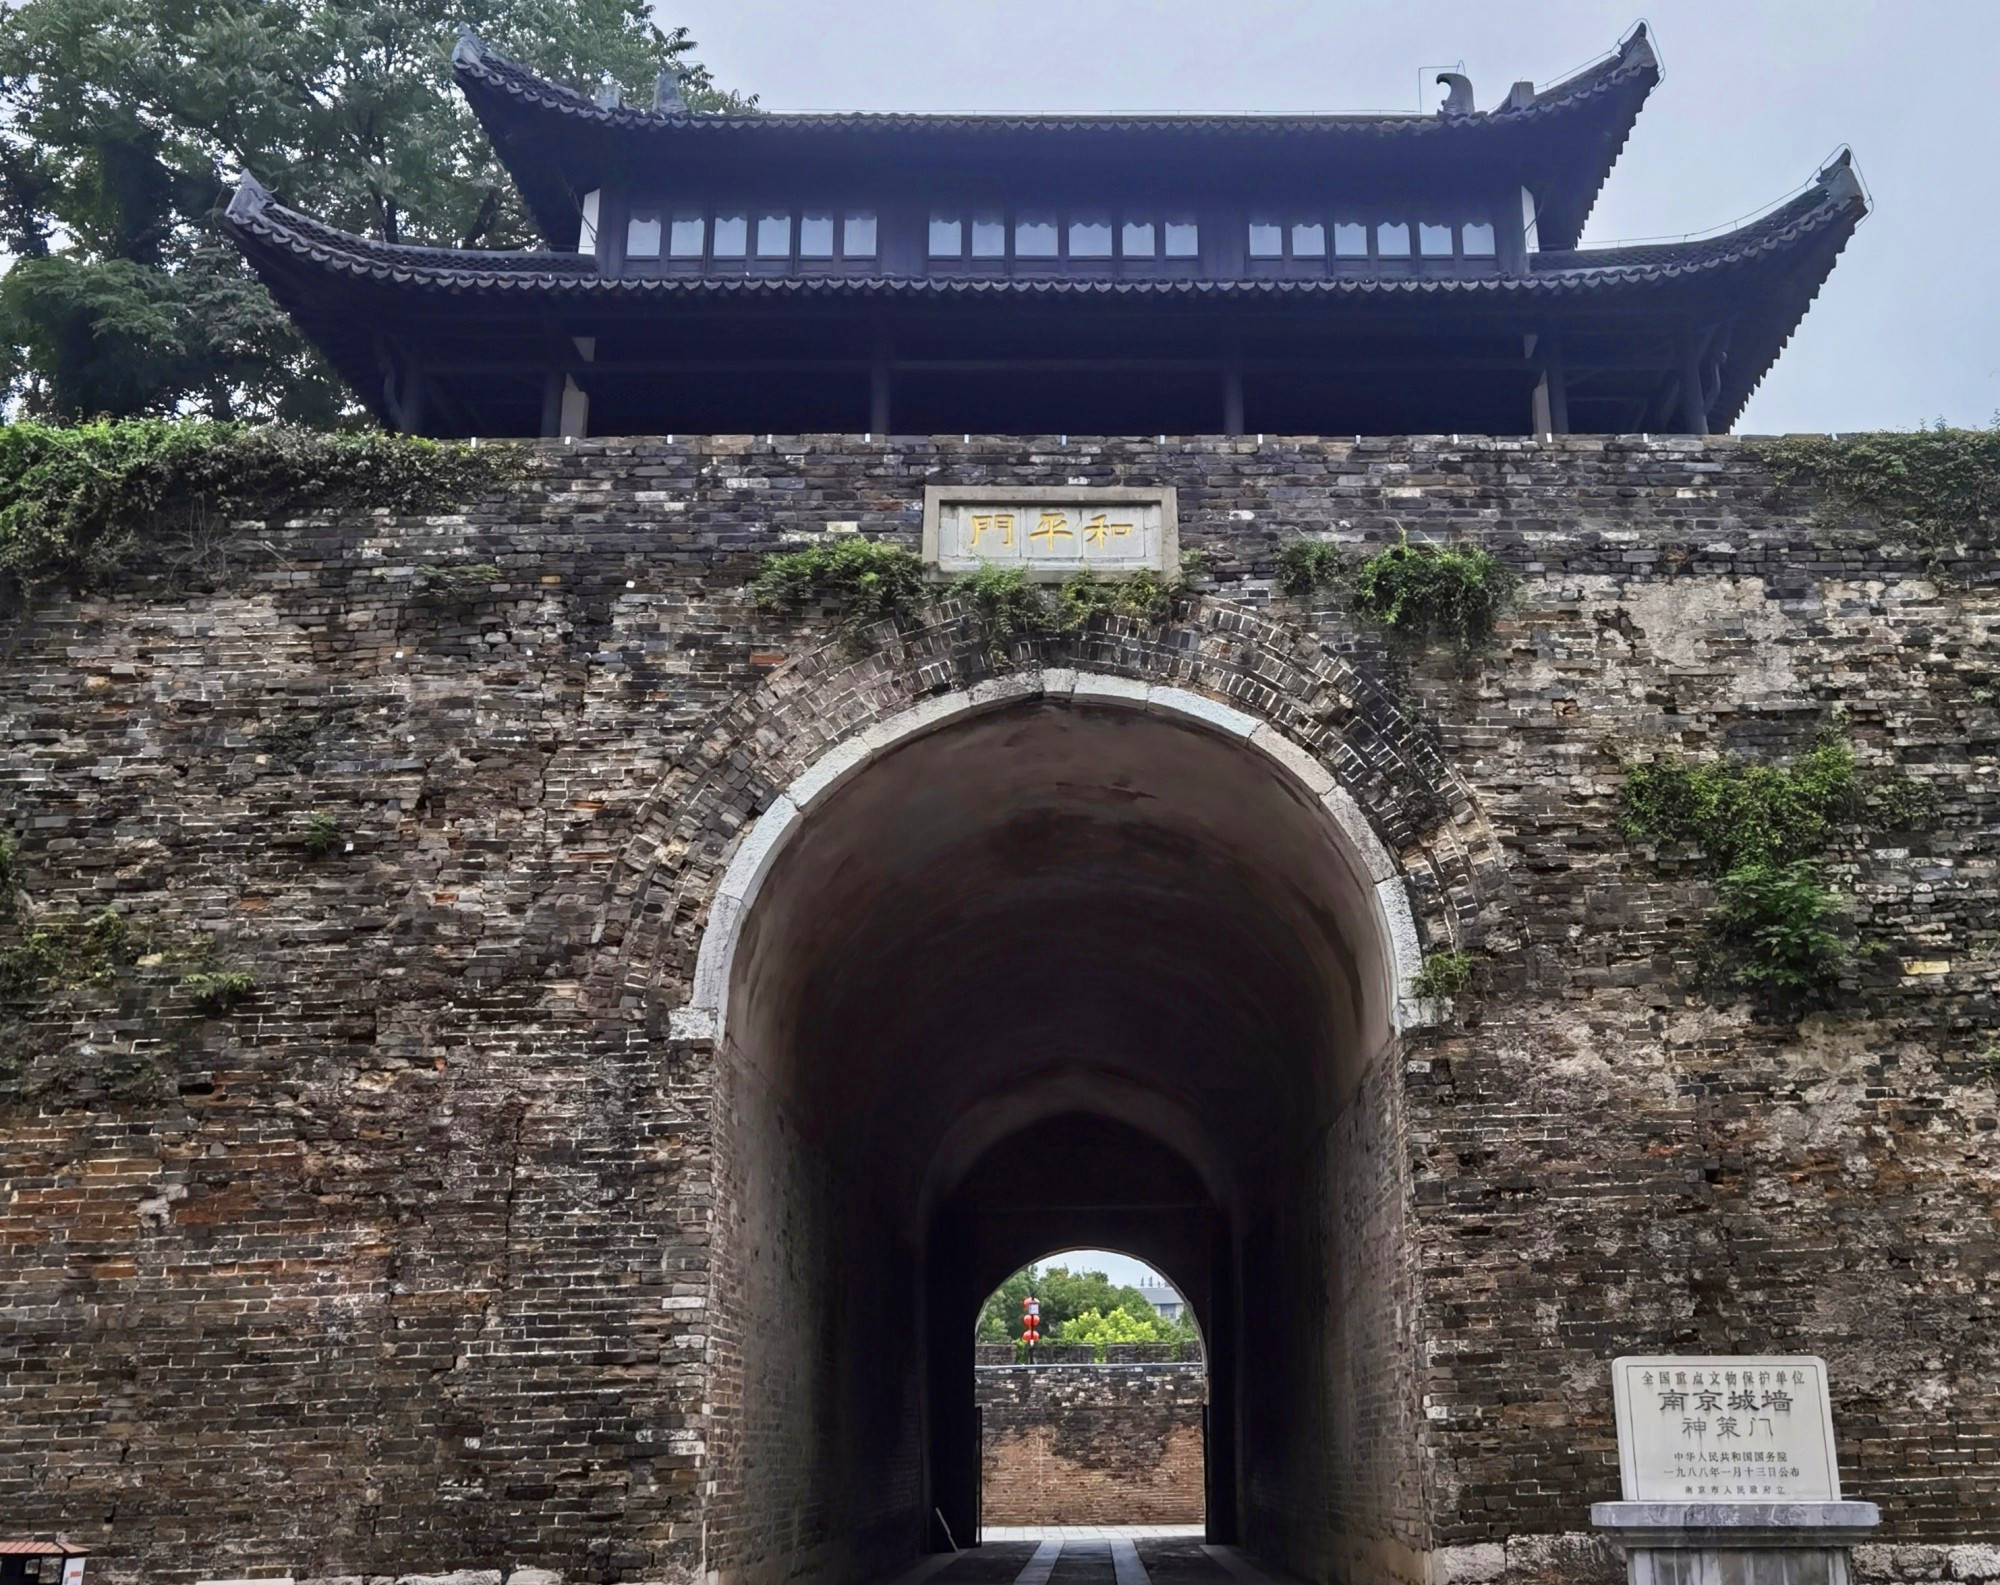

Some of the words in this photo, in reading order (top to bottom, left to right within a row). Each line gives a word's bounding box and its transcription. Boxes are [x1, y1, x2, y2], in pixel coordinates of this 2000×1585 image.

[1642, 1370, 1806, 1385] 全国重点文物保护单位
[1657, 1389, 1793, 1412] 南京城墙
[1682, 1417, 1774, 1438] 神策门
[1674, 1451, 1788, 1463] 中华人民共和国国务院
[1663, 1466, 1800, 1478] 一九八八年一月十三日公布
[1684, 1485, 1787, 1496] 南京市人民政府立
